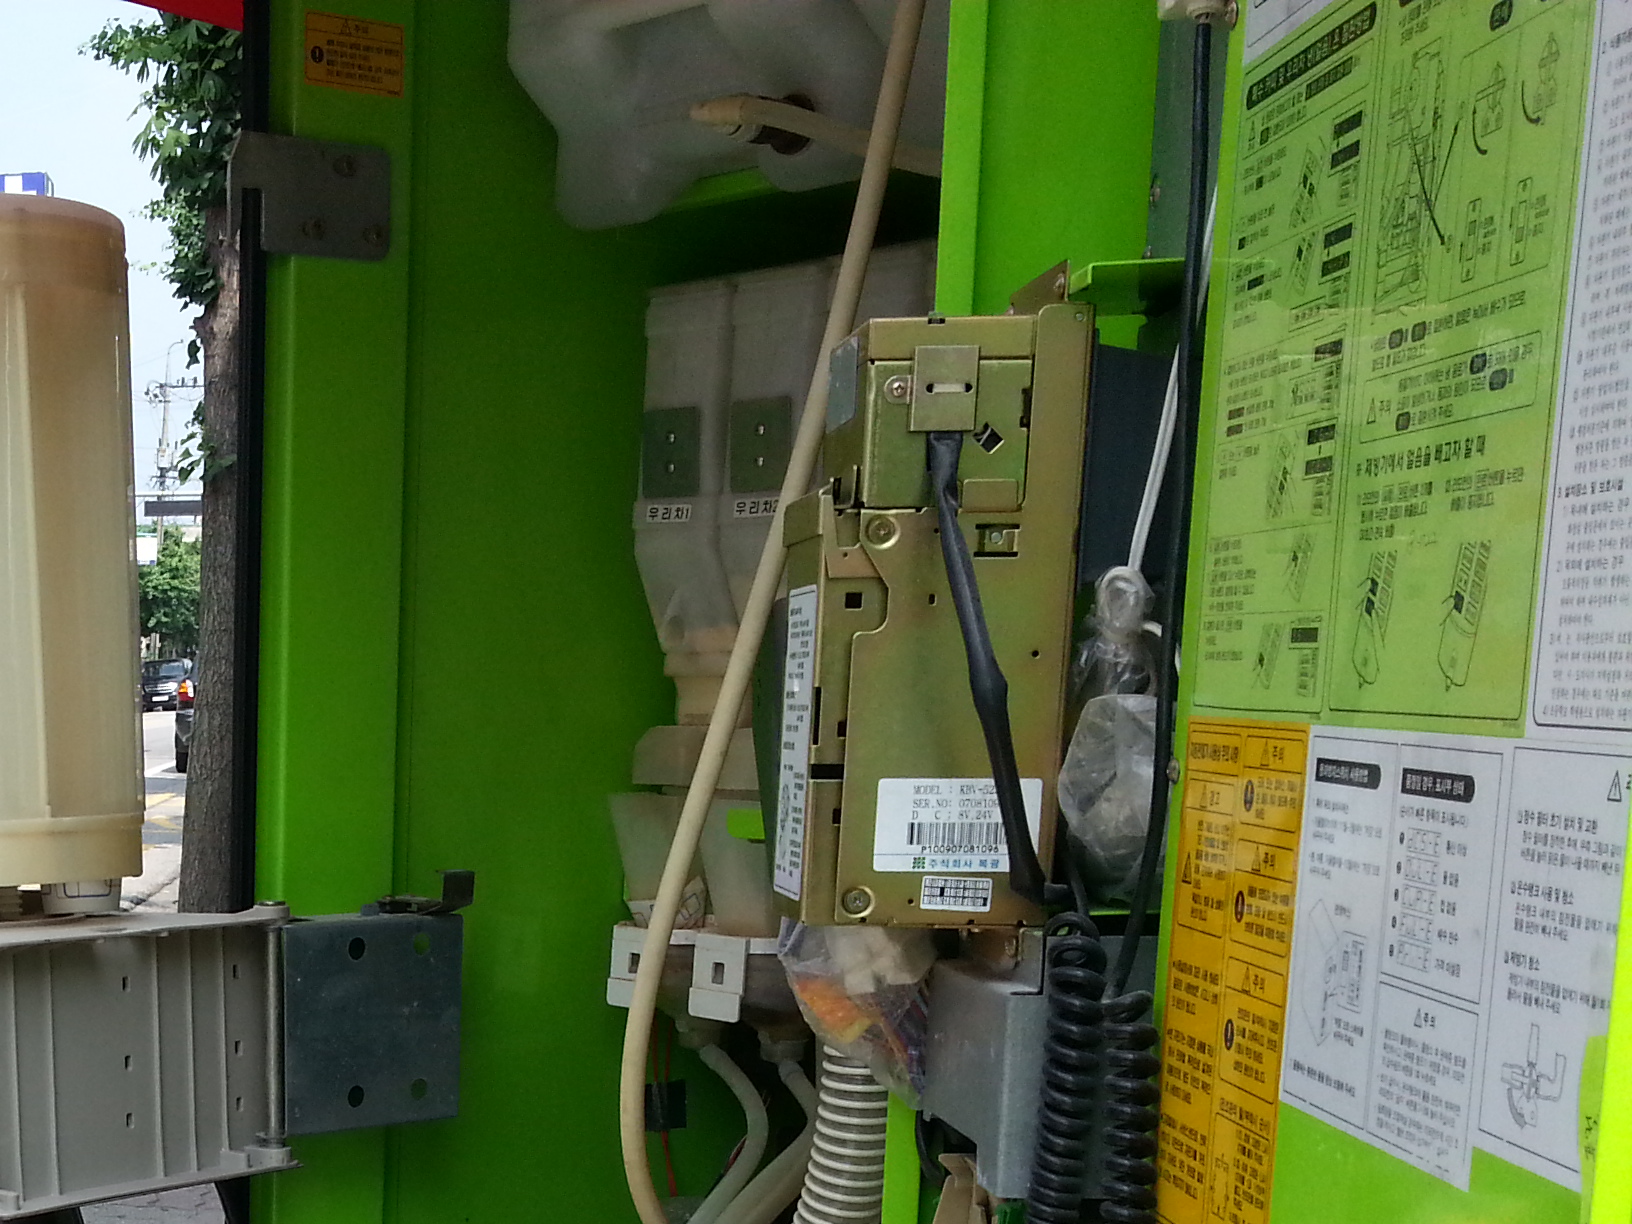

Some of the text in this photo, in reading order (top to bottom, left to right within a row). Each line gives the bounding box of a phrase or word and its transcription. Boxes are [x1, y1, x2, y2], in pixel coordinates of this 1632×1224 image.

[1406, 445, 1432, 471] 얼음을
[1434, 438, 1462, 466] 빼고자
[1464, 436, 1475, 460] 할
[912, 784, 942, 796] MODEL
[921, 845, 1000, 854] P100907081096
[928, 858, 973, 870] 주식회사
